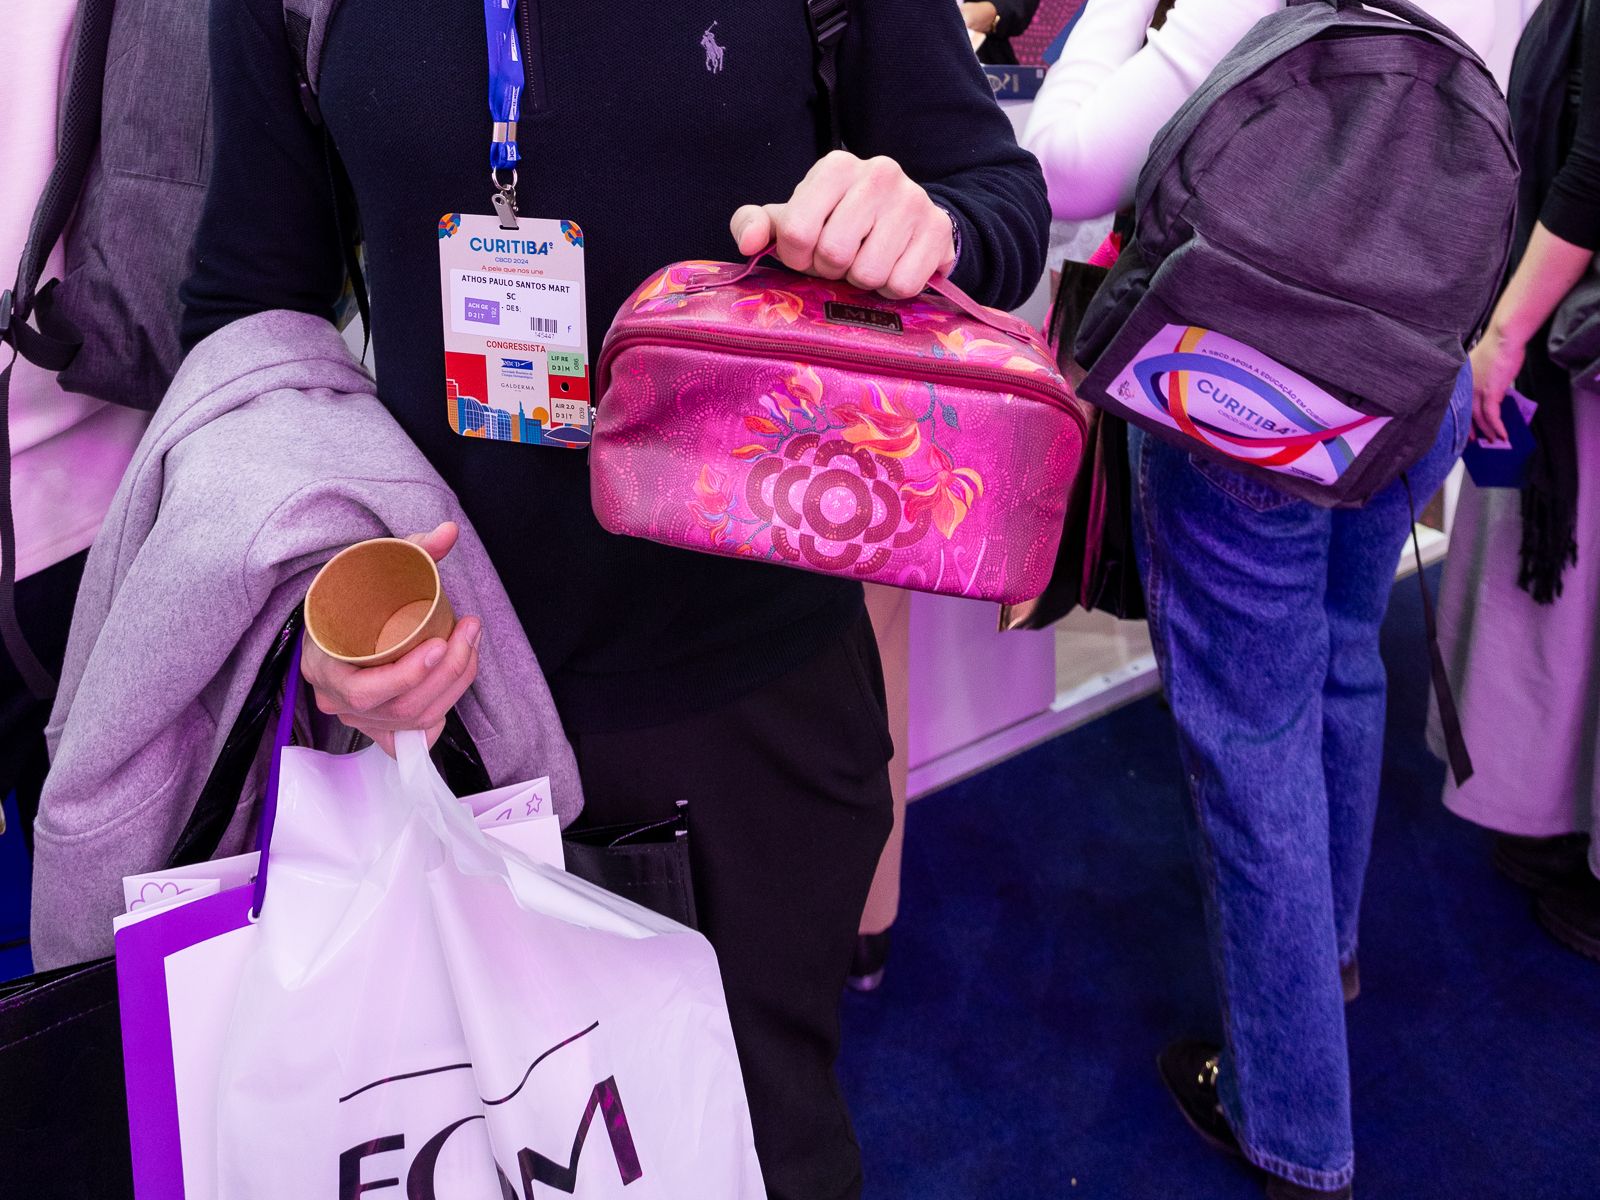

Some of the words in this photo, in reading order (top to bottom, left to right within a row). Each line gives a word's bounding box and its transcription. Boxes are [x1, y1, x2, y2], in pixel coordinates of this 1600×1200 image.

[461, 274, 487, 284] ATHOS
[489, 278, 514, 287] PAULO
[515, 281, 547, 291] SANTOS
[548, 284, 570, 293] MART
[506, 292, 516, 300] SC
[486, 340, 546, 353] CONGRESSISTA
[500, 382, 535, 391] GALDERMA
[1230, 357, 1253, 371] APOIA
[1295, 397, 1307, 409] EM
